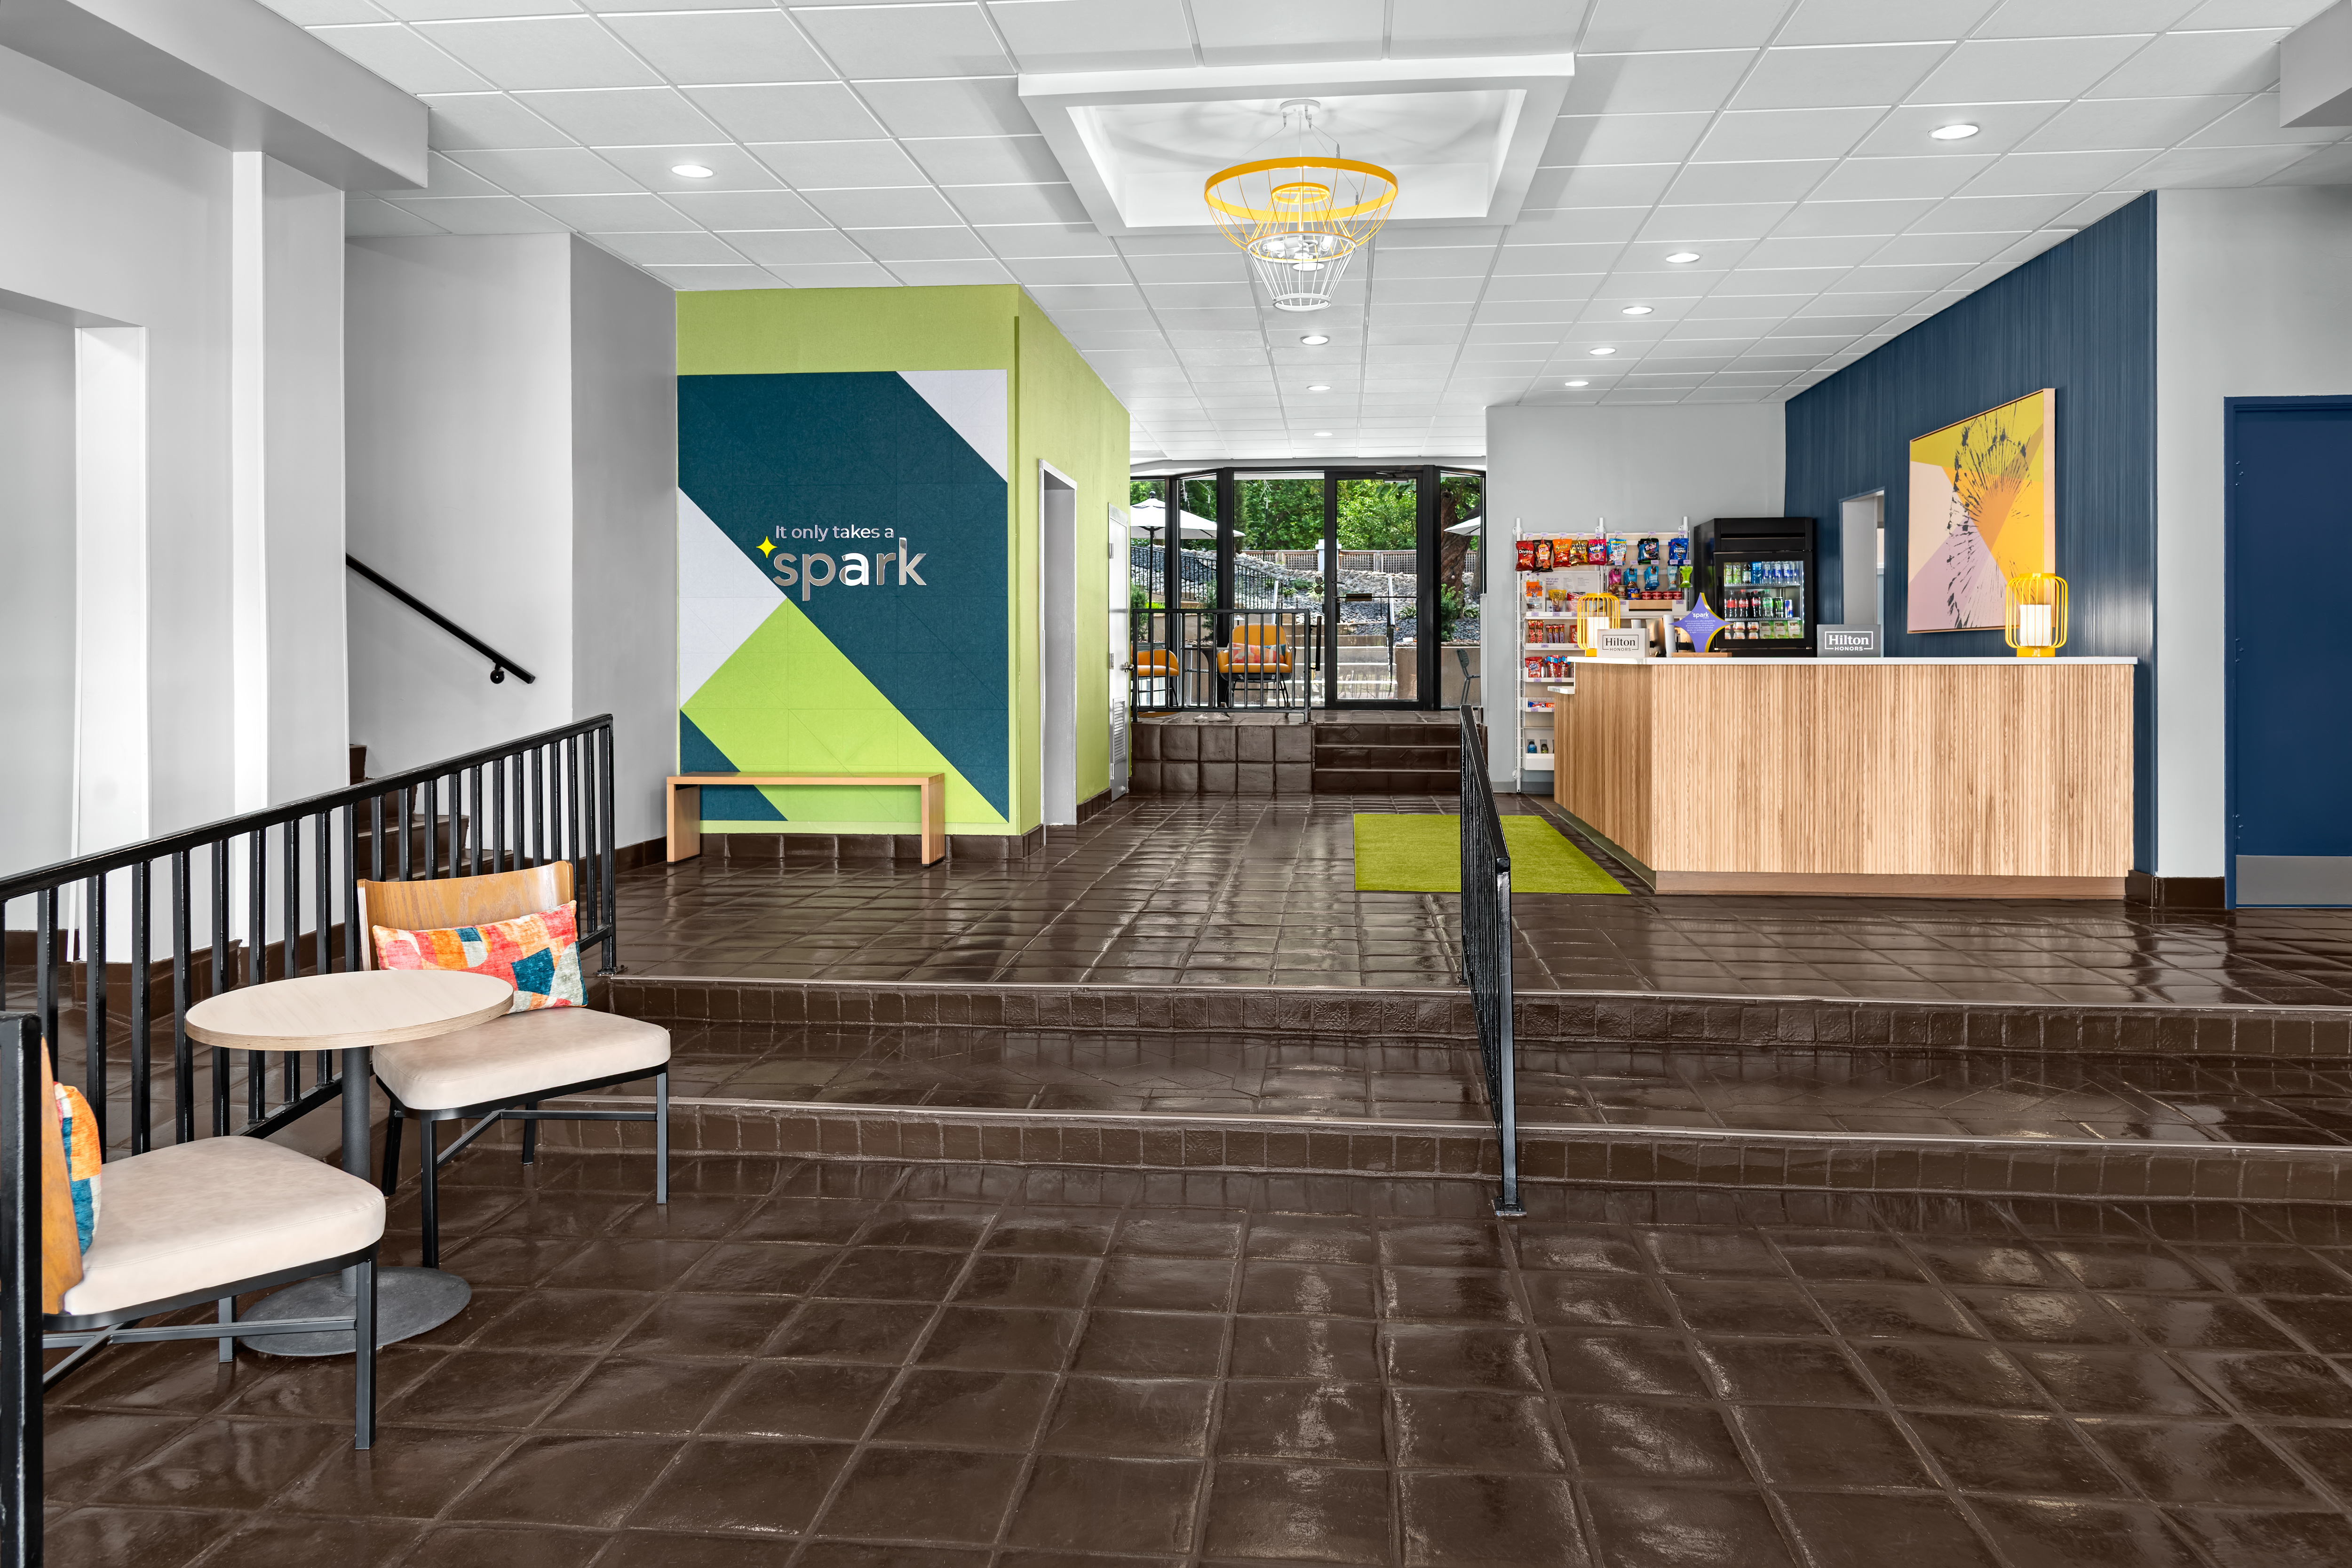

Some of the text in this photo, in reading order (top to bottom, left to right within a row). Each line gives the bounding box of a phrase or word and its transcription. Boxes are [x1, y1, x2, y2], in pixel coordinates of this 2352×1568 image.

[776, 524, 894, 542] It only takes a
[1645, 543, 1657, 551] Trolli
[773, 537, 927, 602] spark
[1605, 638, 1636, 646] Hilton
[1828, 635, 1869, 645] Hilton
